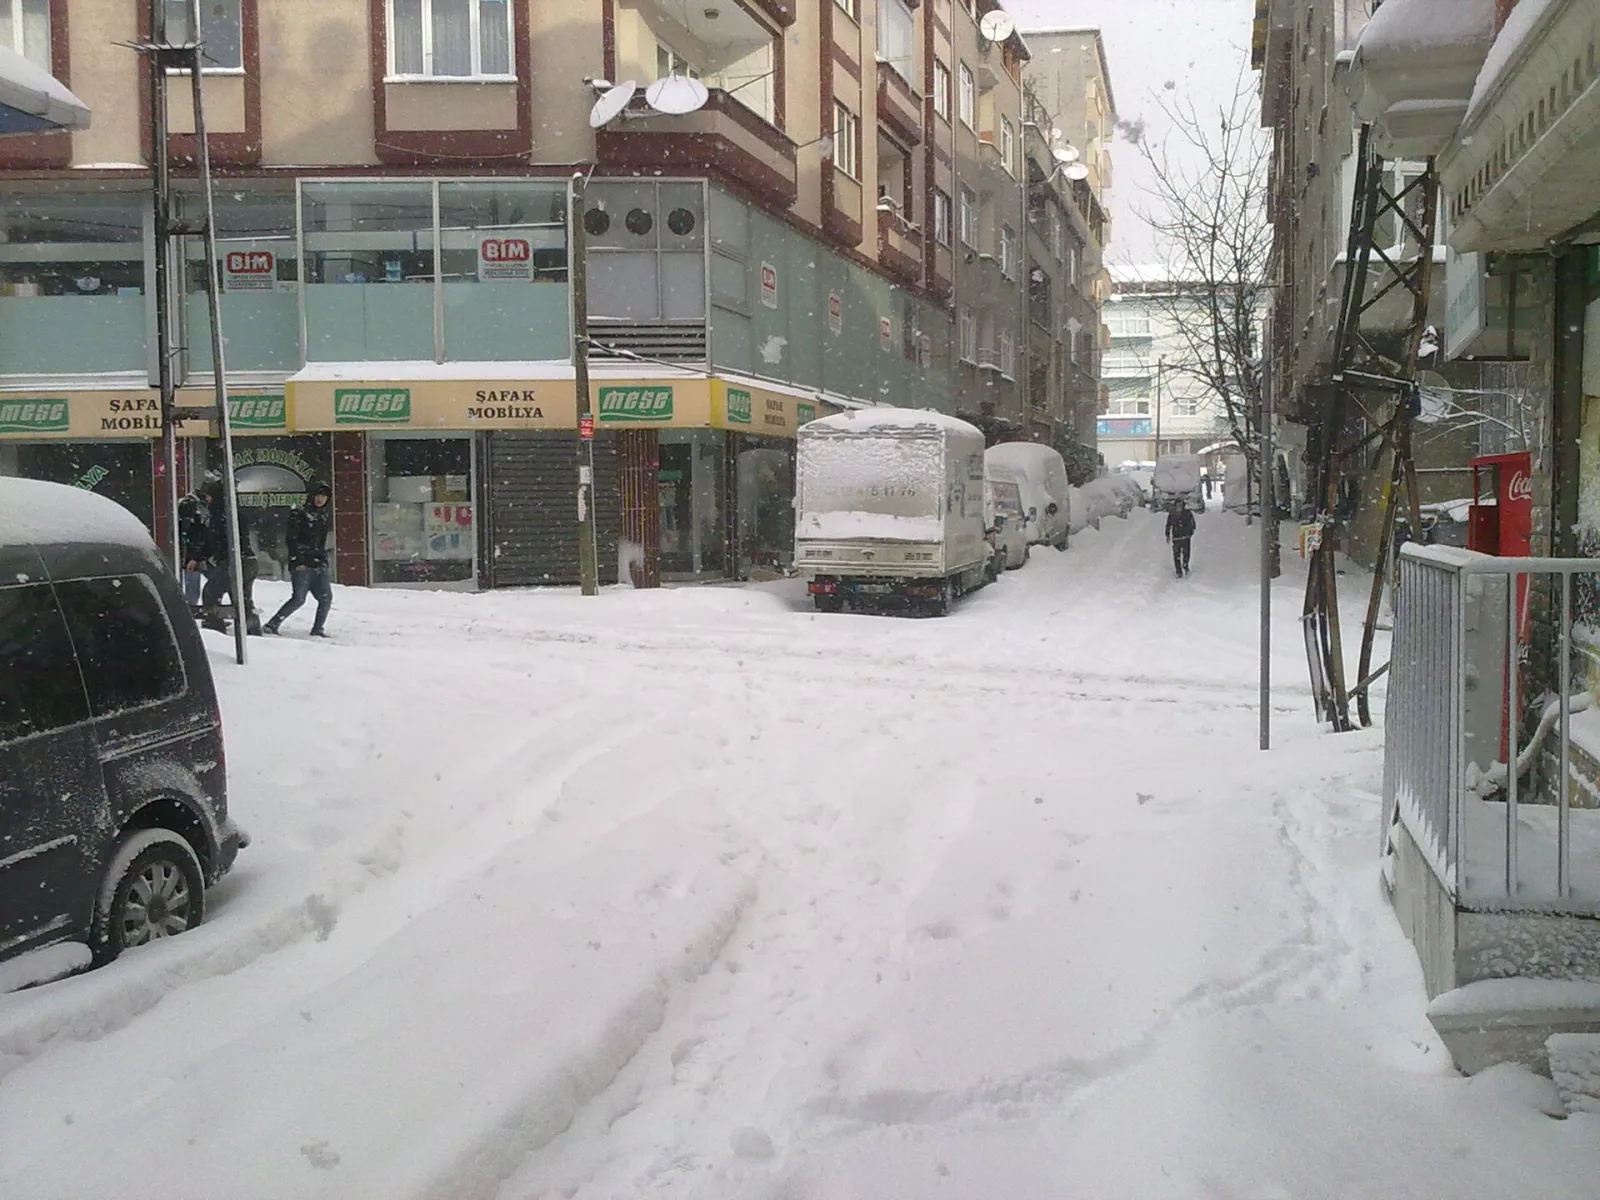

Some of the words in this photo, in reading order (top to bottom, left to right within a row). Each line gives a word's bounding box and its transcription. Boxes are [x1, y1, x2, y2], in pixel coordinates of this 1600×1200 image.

[476, 390, 535, 404] ŞAFAK
[109, 399, 162, 413] ŞAFA
[467, 405, 544, 418] MOBİLYA
[101, 415, 185, 430] MOBİLA
